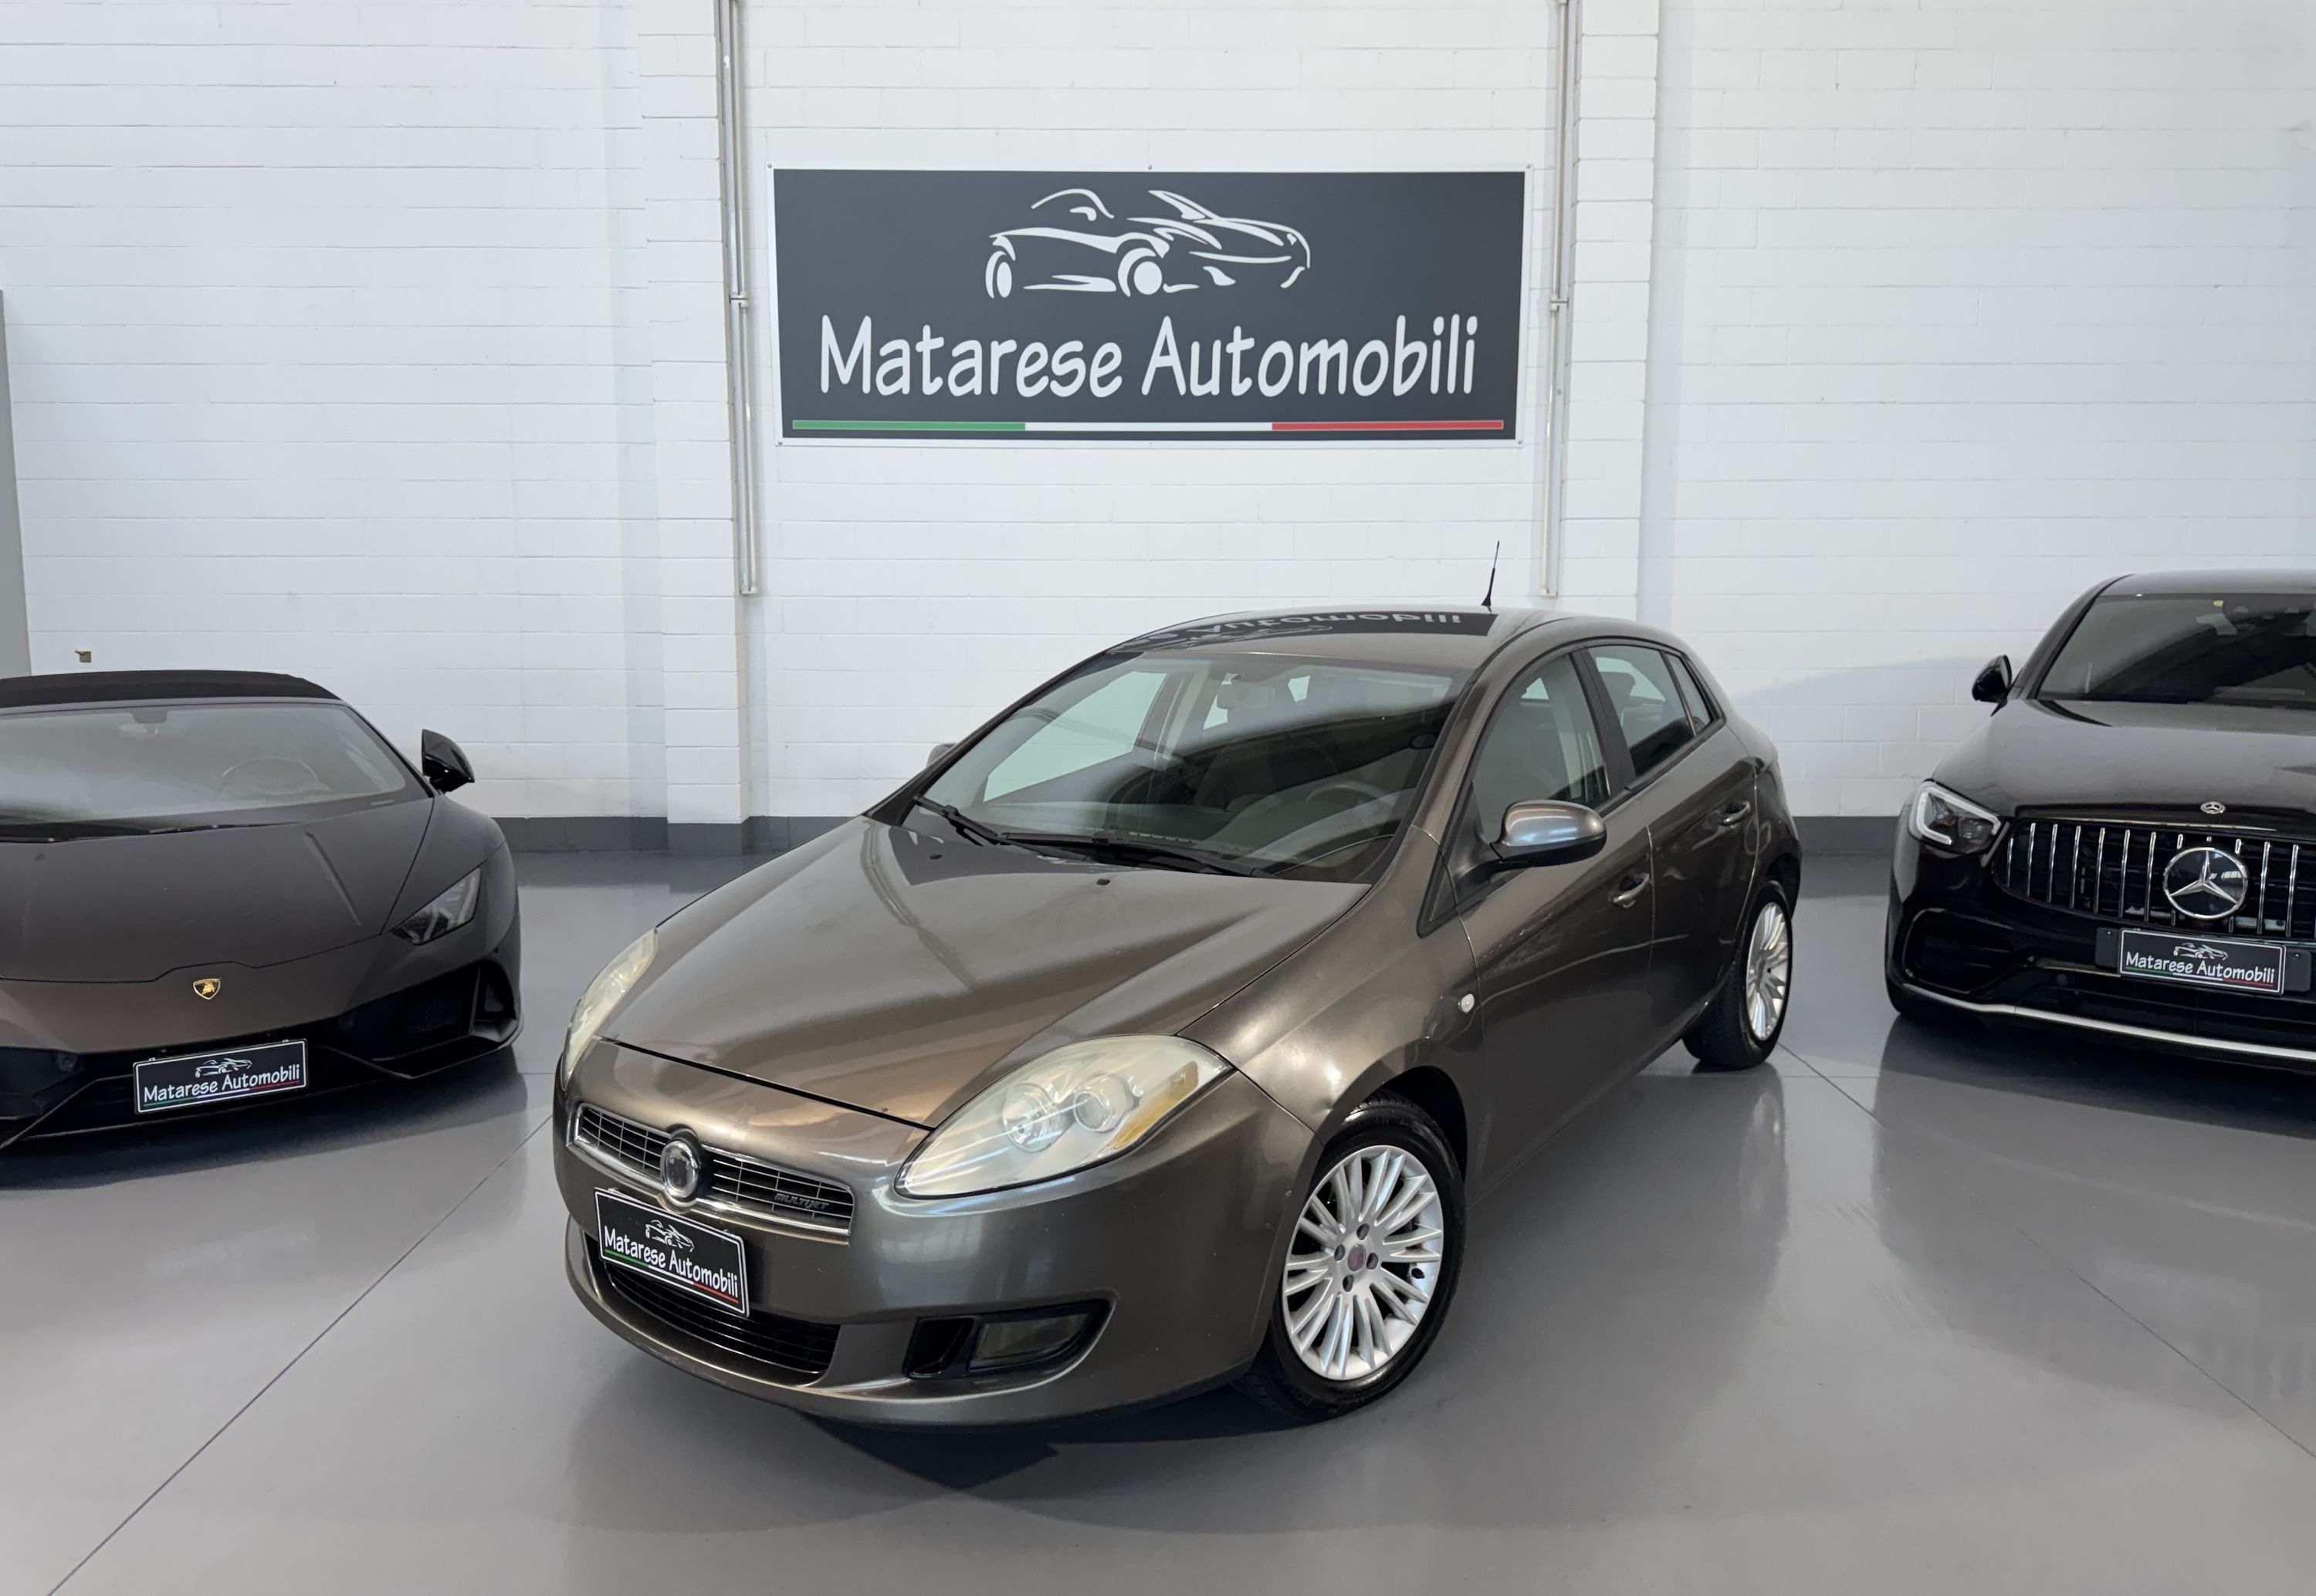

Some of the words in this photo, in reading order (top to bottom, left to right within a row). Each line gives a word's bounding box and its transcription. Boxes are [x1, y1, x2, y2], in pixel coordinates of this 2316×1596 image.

[821, 315, 1123, 397] Matarese
[1142, 314, 1478, 397] Automobili
[2127, 952, 2193, 973] Matarese
[2197, 961, 2274, 983] Automobili
[144, 1081, 218, 1102] Matarese
[222, 1064, 300, 1091] Automobili
[604, 1226, 666, 1267] Matarese
[669, 1251, 738, 1297] Automobili
